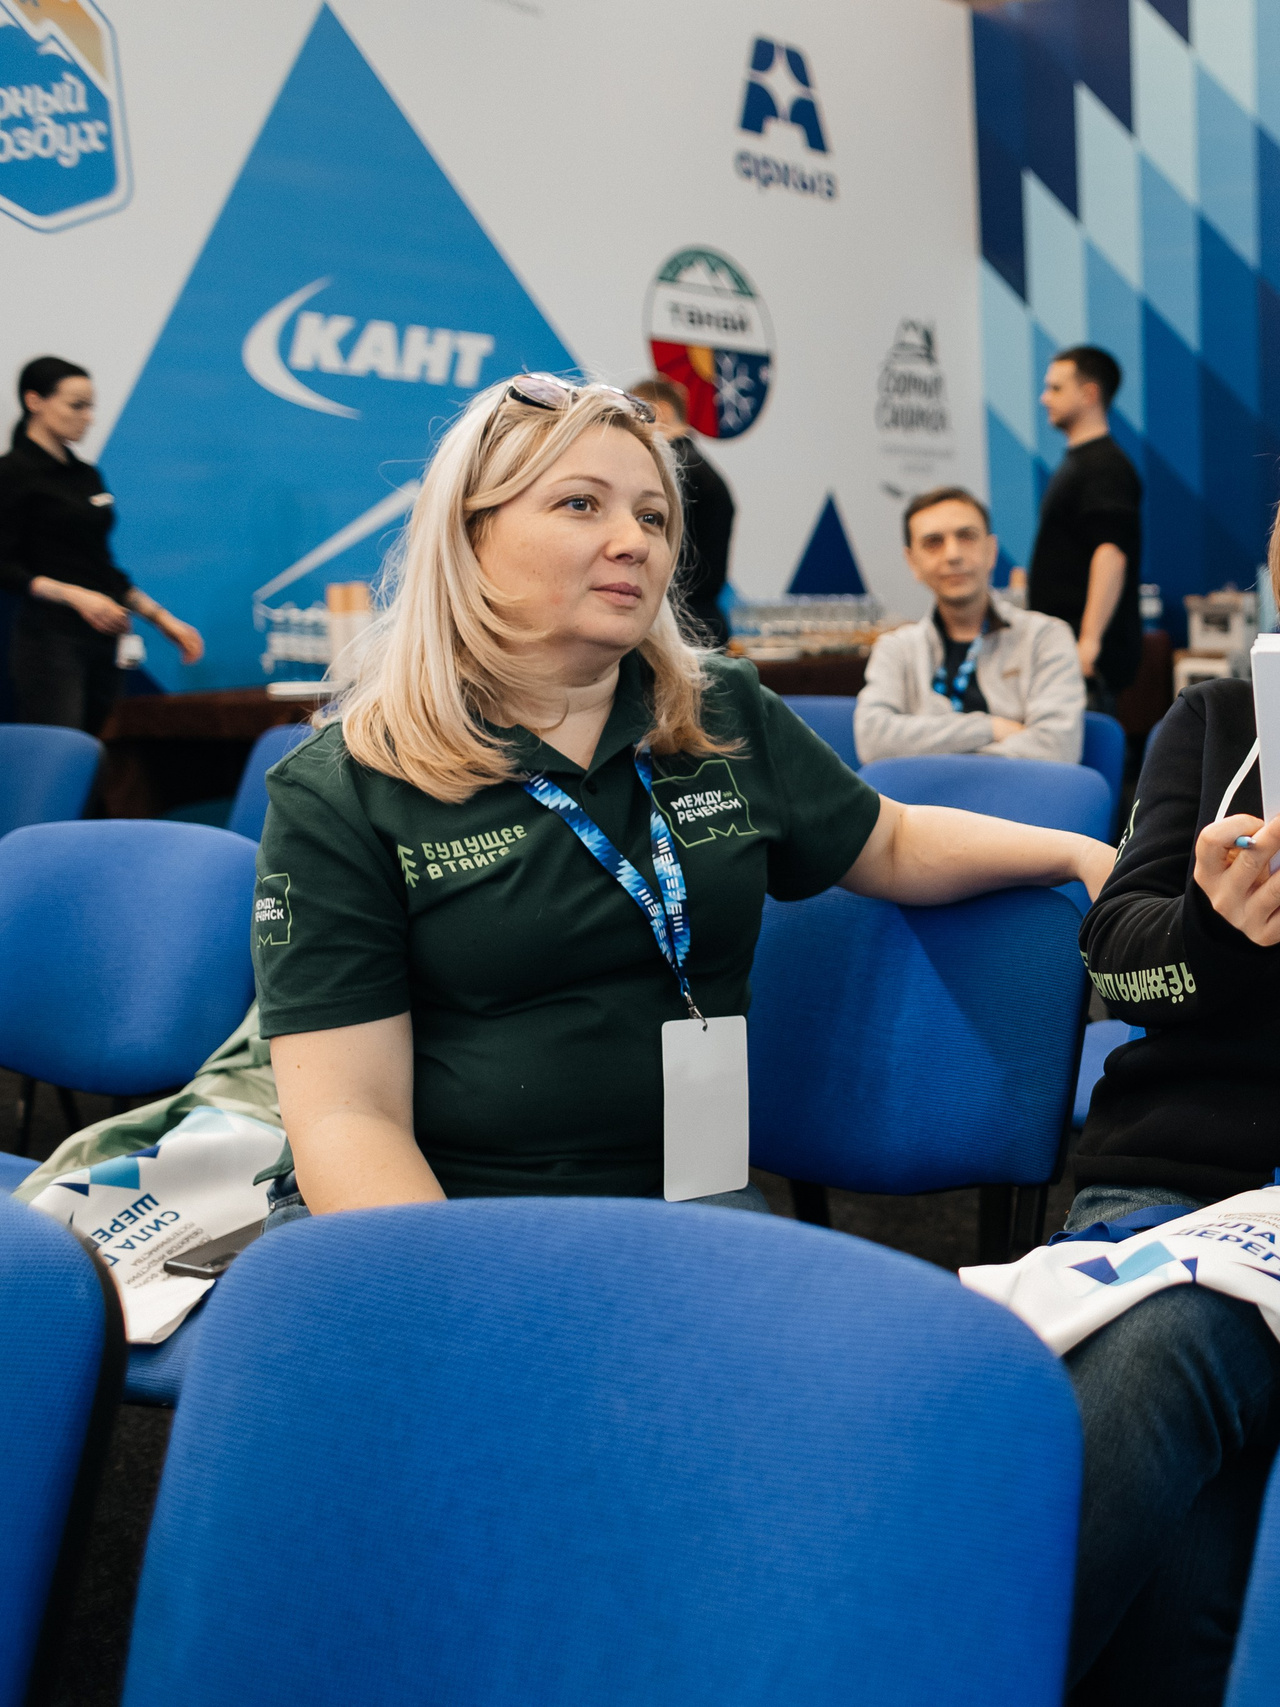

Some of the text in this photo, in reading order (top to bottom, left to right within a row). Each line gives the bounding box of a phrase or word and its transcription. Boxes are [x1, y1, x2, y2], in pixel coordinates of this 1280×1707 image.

[288, 310, 495, 389] КАНТ
[670, 789, 722, 811] МЕЖДУ
[421, 824, 528, 861] БУДУЩЕЕ
[426, 862, 444, 880] В
[90, 1192, 161, 1246] ШЕРЕ
[115, 1209, 182, 1251] СИЛА
